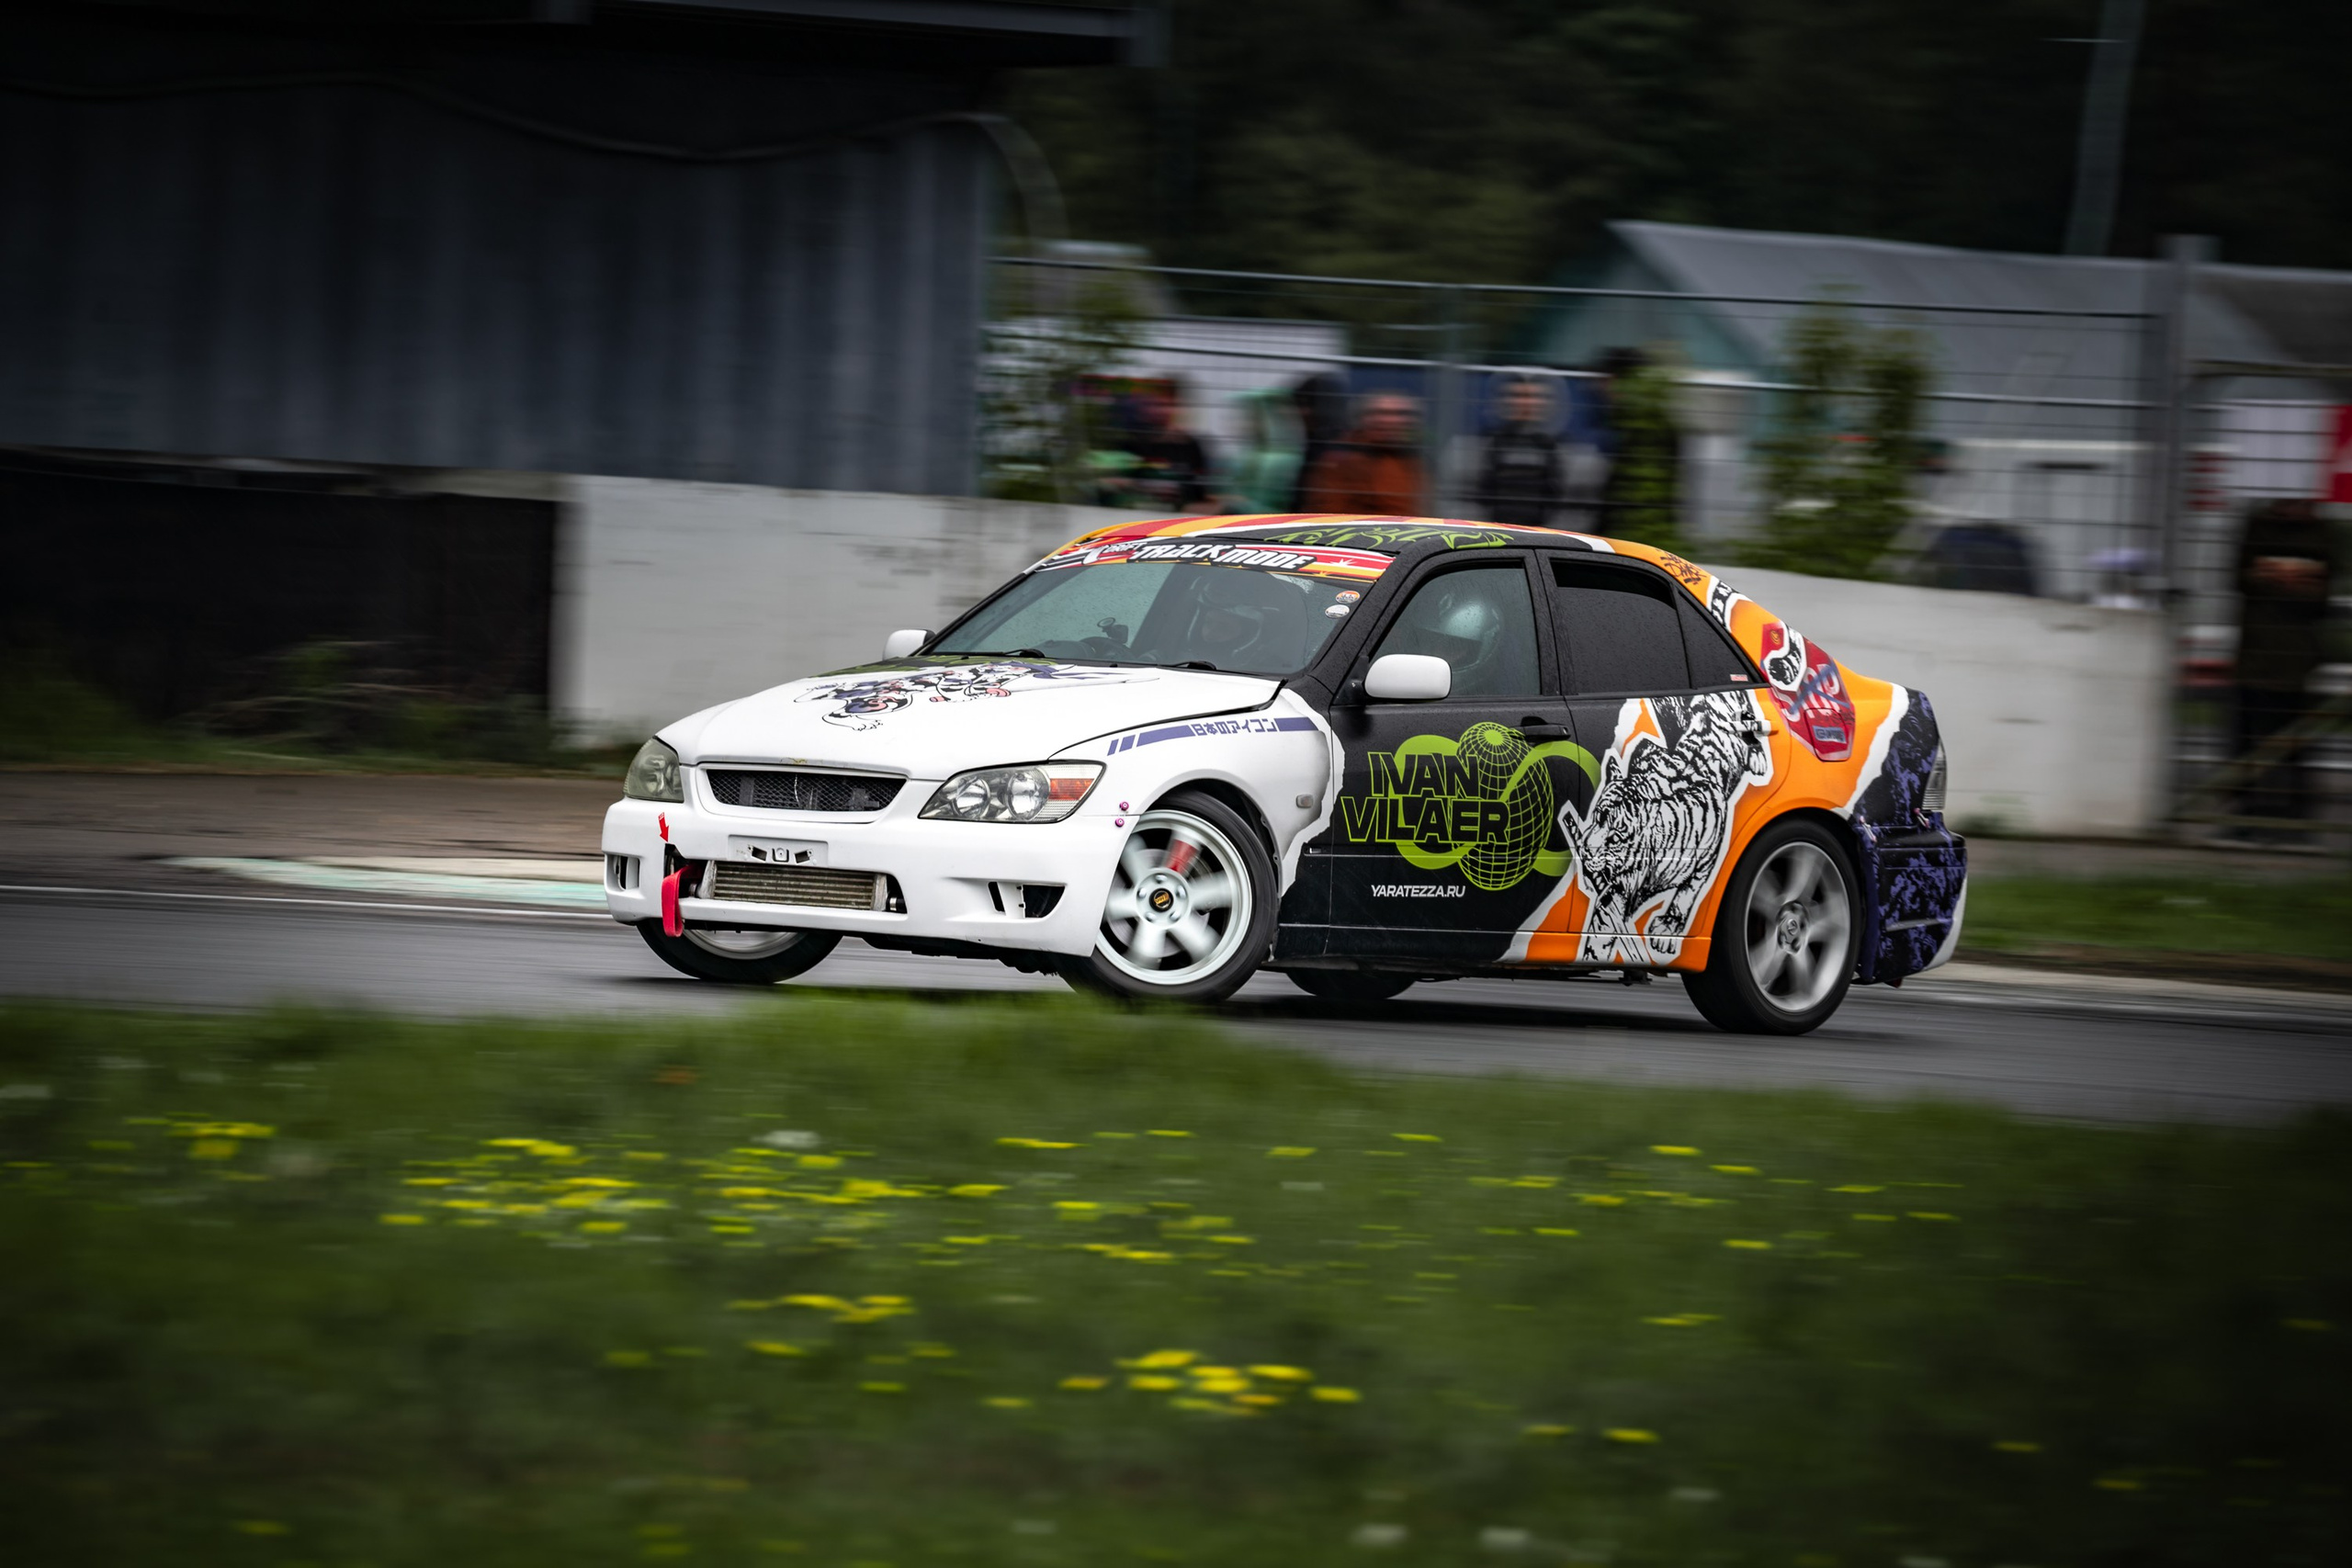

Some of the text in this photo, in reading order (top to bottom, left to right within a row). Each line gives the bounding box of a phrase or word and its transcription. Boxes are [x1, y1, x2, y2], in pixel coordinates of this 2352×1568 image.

[1191, 717, 1277, 736] 日本のアイコン
[1367, 751, 1481, 798] IVAN
[1340, 795, 1510, 844] VILAER
[1371, 885, 1466, 898] YARATEZZA.RU
